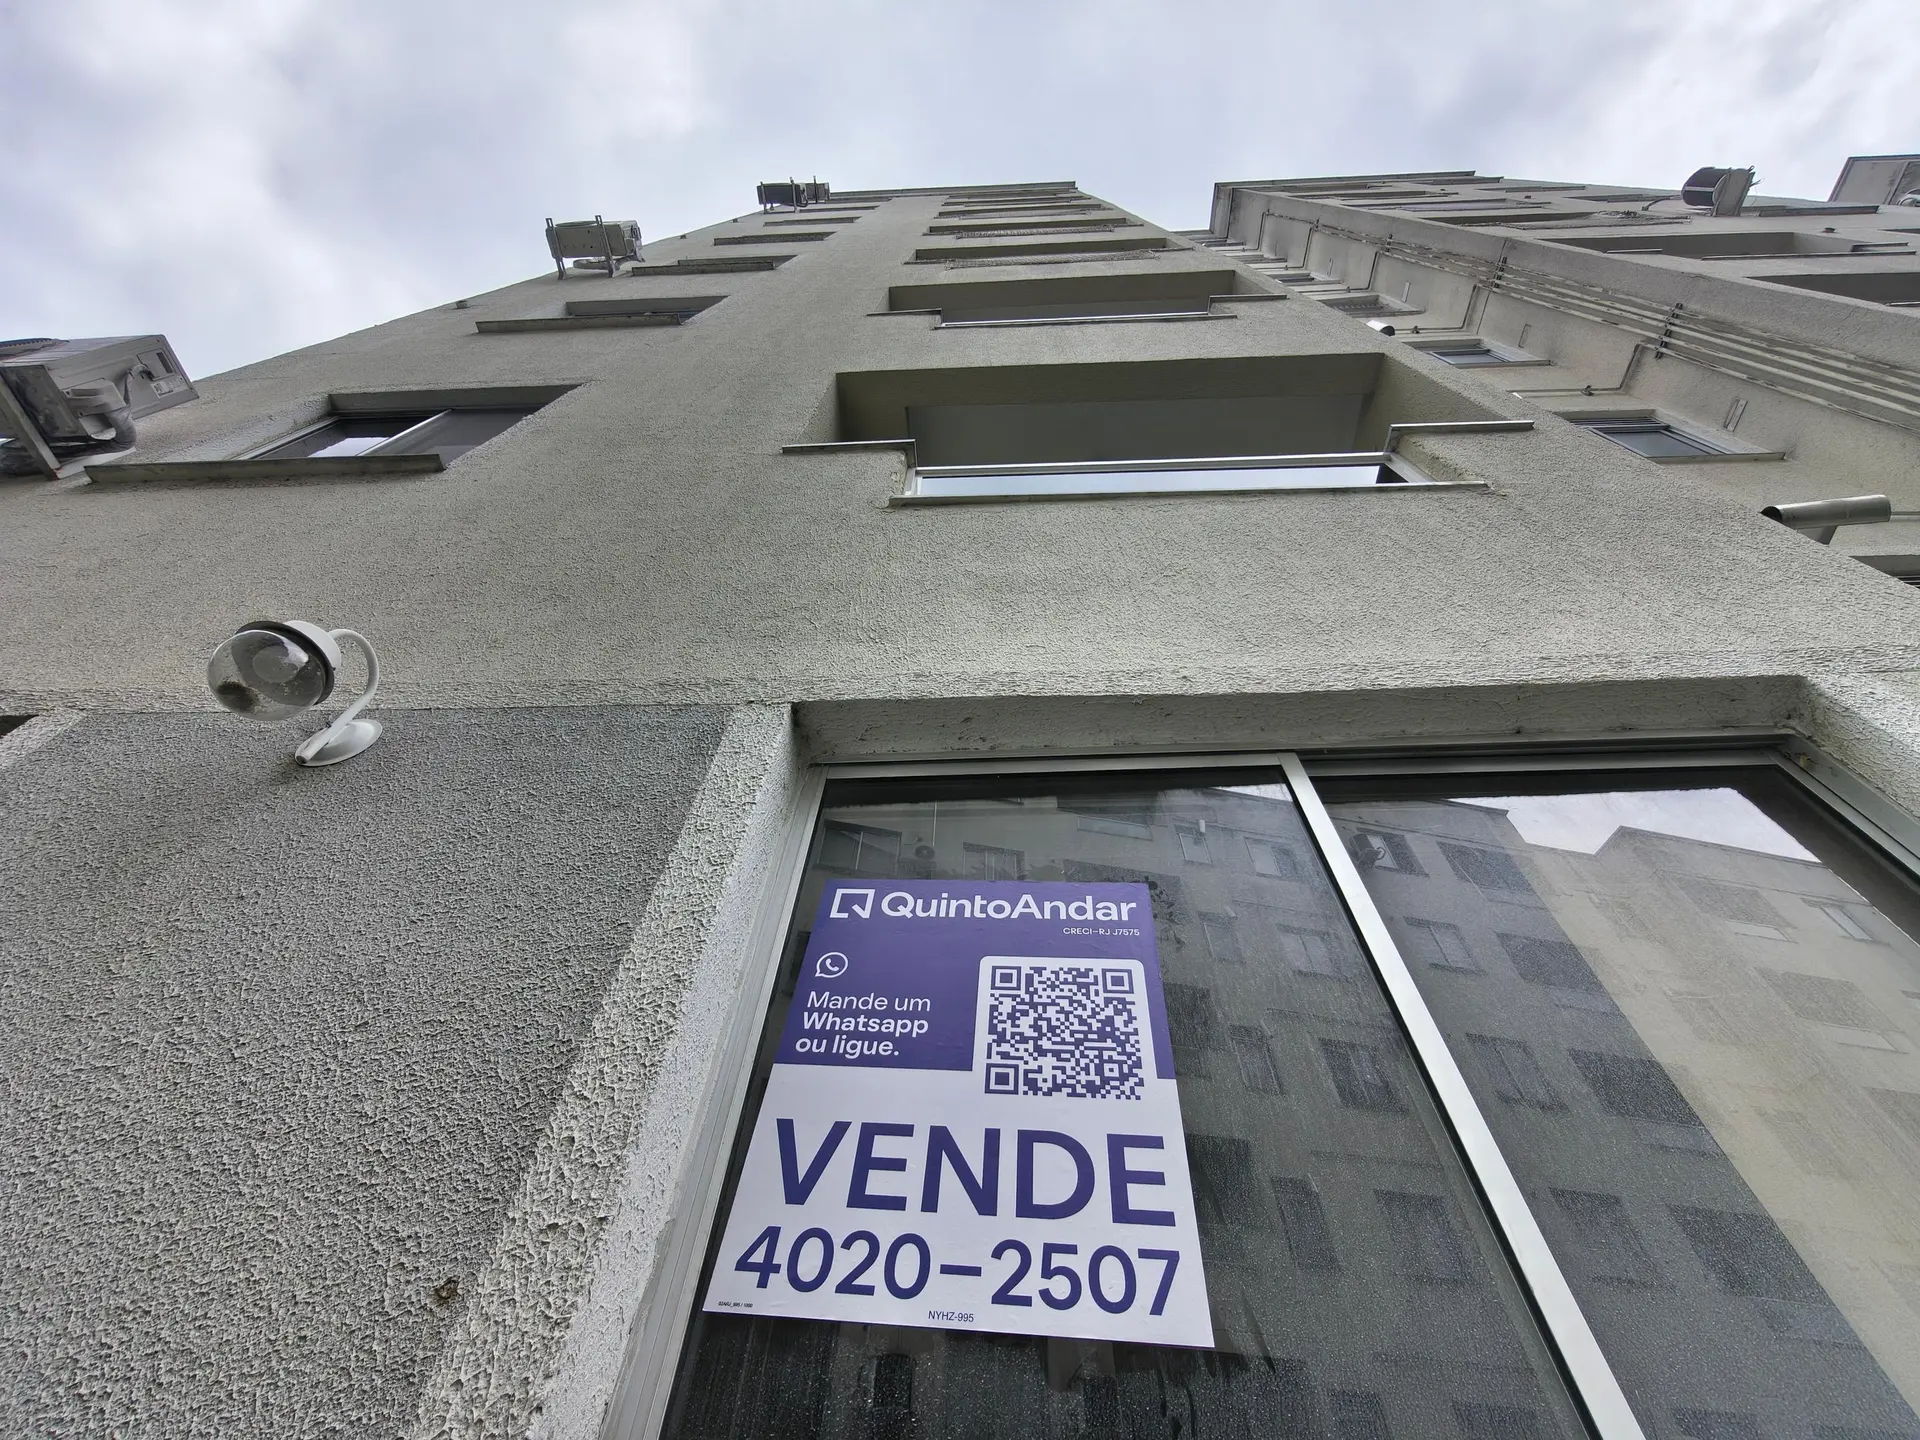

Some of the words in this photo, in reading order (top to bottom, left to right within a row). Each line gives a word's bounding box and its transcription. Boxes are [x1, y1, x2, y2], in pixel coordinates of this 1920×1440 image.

[881, 891, 1136, 921] QuintoAndar
[1062, 927, 1111, 936] CRECI-RJ
[1112, 928, 1140, 936] J7575
[807, 991, 888, 1012] Mande
[894, 996, 931, 1012] um
[802, 1011, 929, 1035] Whatsapp
[795, 1038, 826, 1053] ou
[832, 1035, 900, 1058] ligue.
[776, 1118, 1176, 1227] VENDE
[735, 1225, 1181, 1316] 4020-2507
[928, 1310, 974, 1322] NYHZ-995
